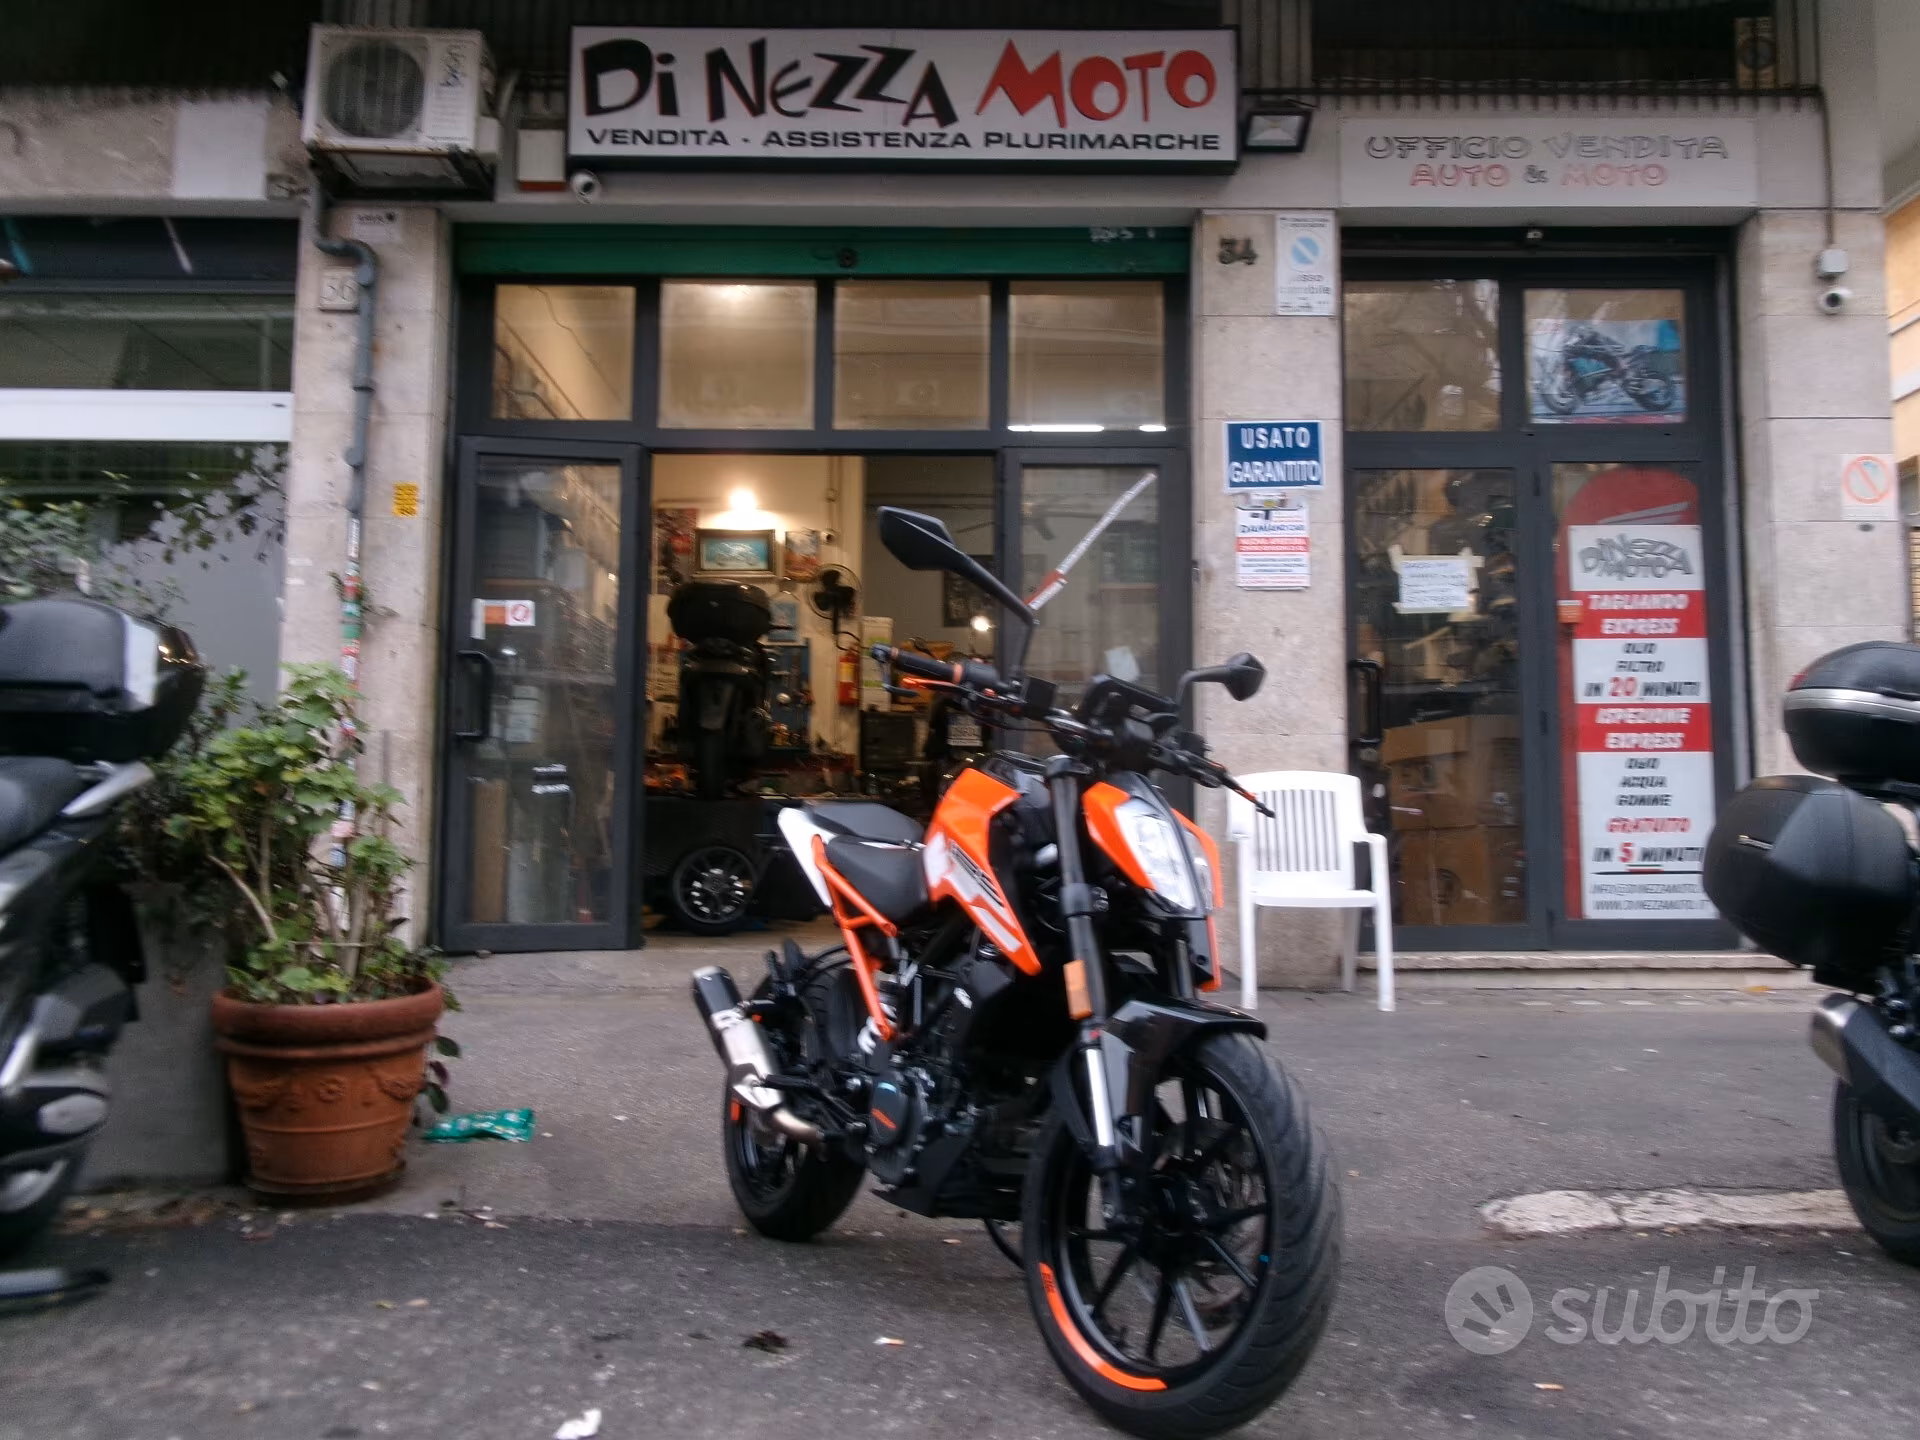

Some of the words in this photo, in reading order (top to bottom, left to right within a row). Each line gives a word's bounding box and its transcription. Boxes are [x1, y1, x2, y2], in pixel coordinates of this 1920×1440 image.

[975, 37, 1217, 128] MOTO
[587, 129, 730, 145] VENDITA
[762, 131, 971, 148] ASSISTENZA
[984, 132, 1220, 150] PLURIMARCHE
[1364, 134, 1533, 159] UFFICIO
[1541, 131, 1729, 159] VENDITA
[1409, 163, 1511, 187] AUTO
[1522, 165, 1549, 184] &
[1560, 163, 1668, 187] MOTO
[1218, 237, 1258, 265] 34
[1240, 427, 1311, 449] USATO
[1229, 460, 1322, 483] GARANTITO
[1601, 618, 1680, 634] EXPRESS
[1623, 642, 1657, 654] OLIO
[1584, 682, 1604, 696] IN
[1608, 677, 1638, 697] 20
[1605, 732, 1686, 749] EXPRESS
[1618, 776, 1668, 788] ACQUA
[1592, 847, 1613, 862] IN
[1618, 842, 1636, 863] 5
